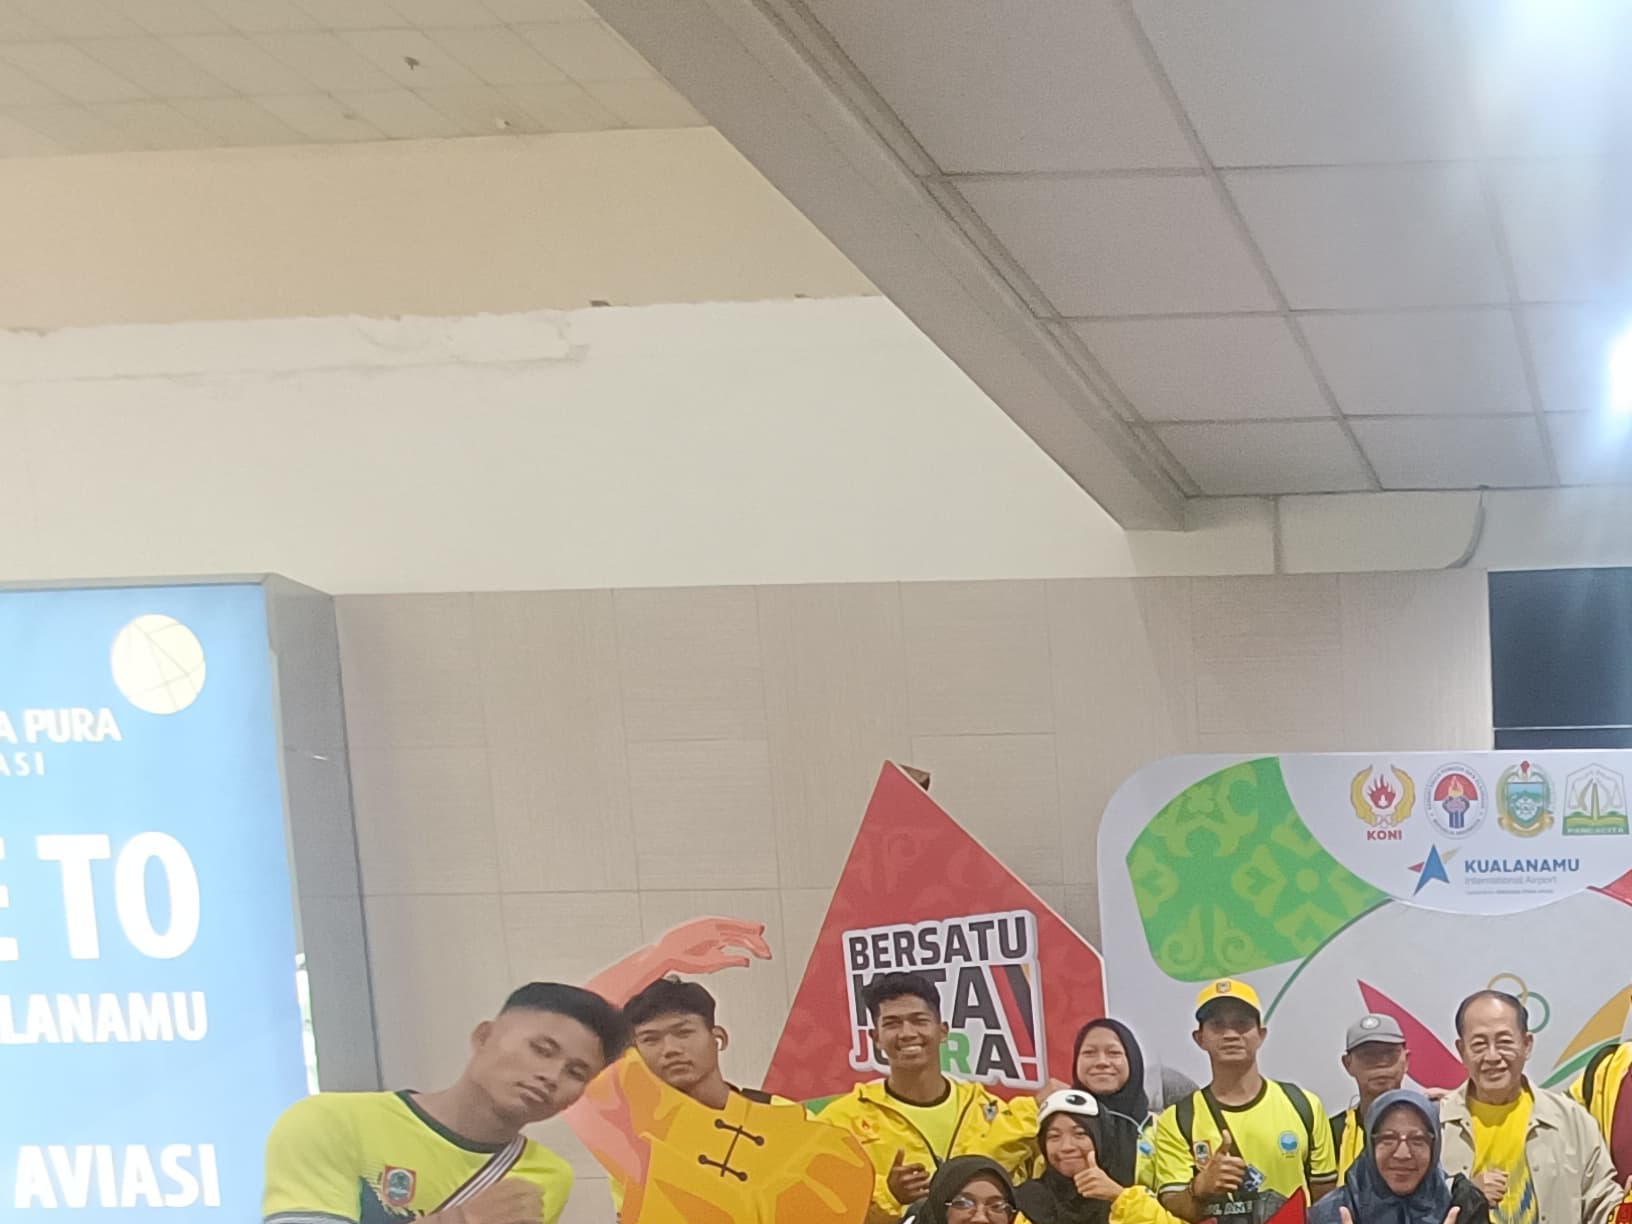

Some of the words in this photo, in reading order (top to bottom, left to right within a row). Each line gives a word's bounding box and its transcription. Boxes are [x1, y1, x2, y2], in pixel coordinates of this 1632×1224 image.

[24, 707, 122, 743] PURA
[1366, 829, 1403, 841] KONI
[1464, 858, 1580, 874] KUALANAMU
[36, 831, 200, 960] TO
[848, 916, 1028, 971] BERSATU
[14, 1144, 222, 1209] AVIASI
